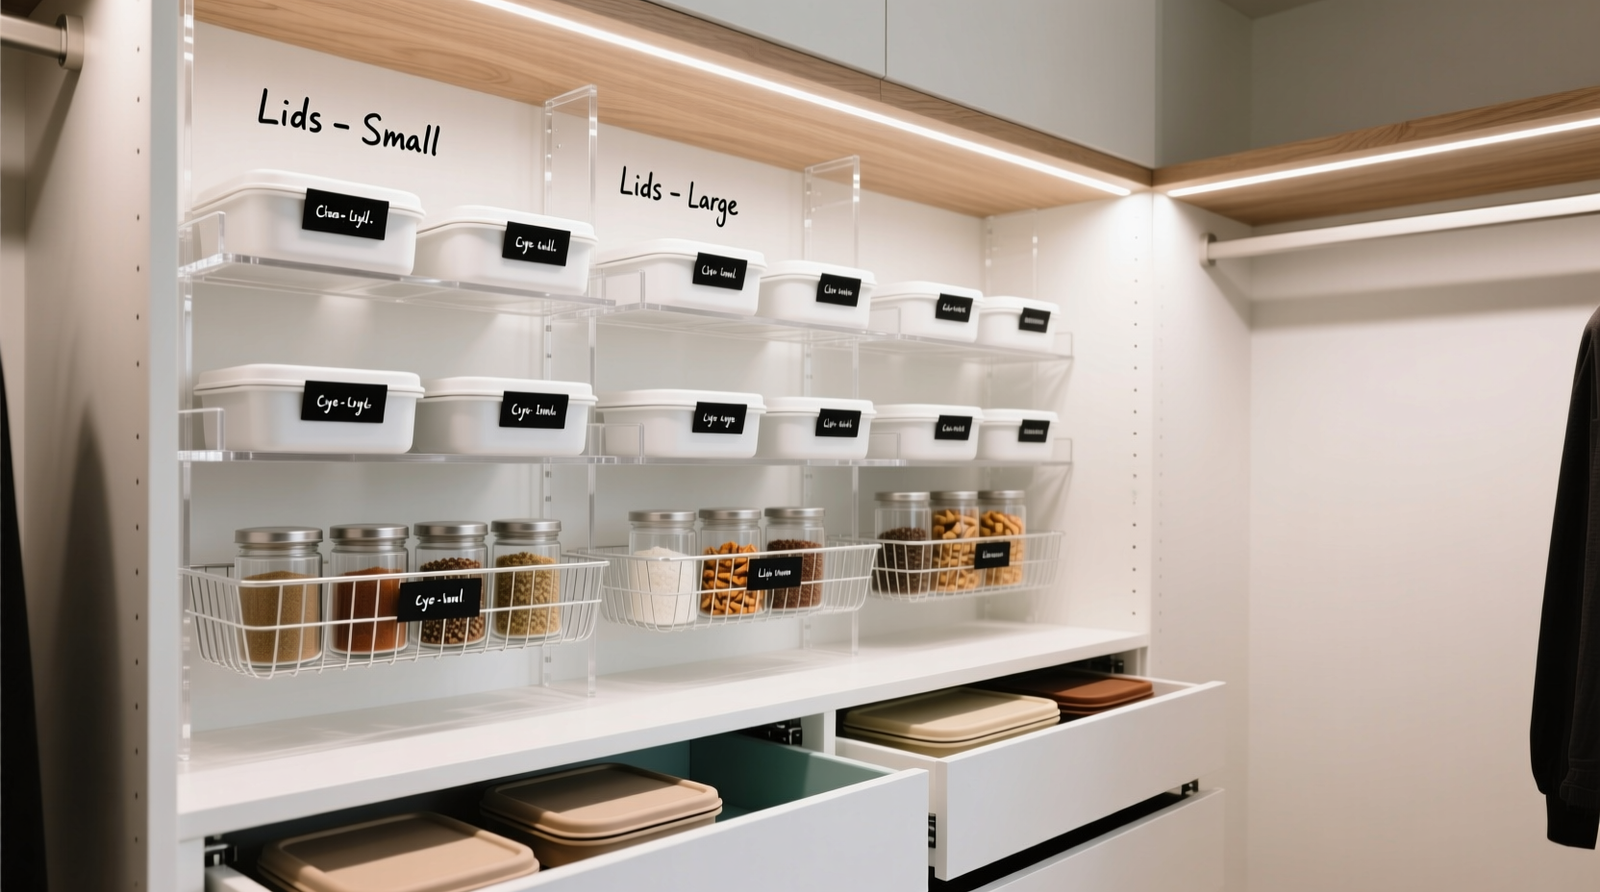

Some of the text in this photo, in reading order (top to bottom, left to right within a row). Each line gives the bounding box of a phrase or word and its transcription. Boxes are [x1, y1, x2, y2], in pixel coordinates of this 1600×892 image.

[257, 87, 323, 134] Lids
[361, 112, 442, 157] Small
[619, 165, 662, 201] Lids
[688, 180, 739, 228] Large
